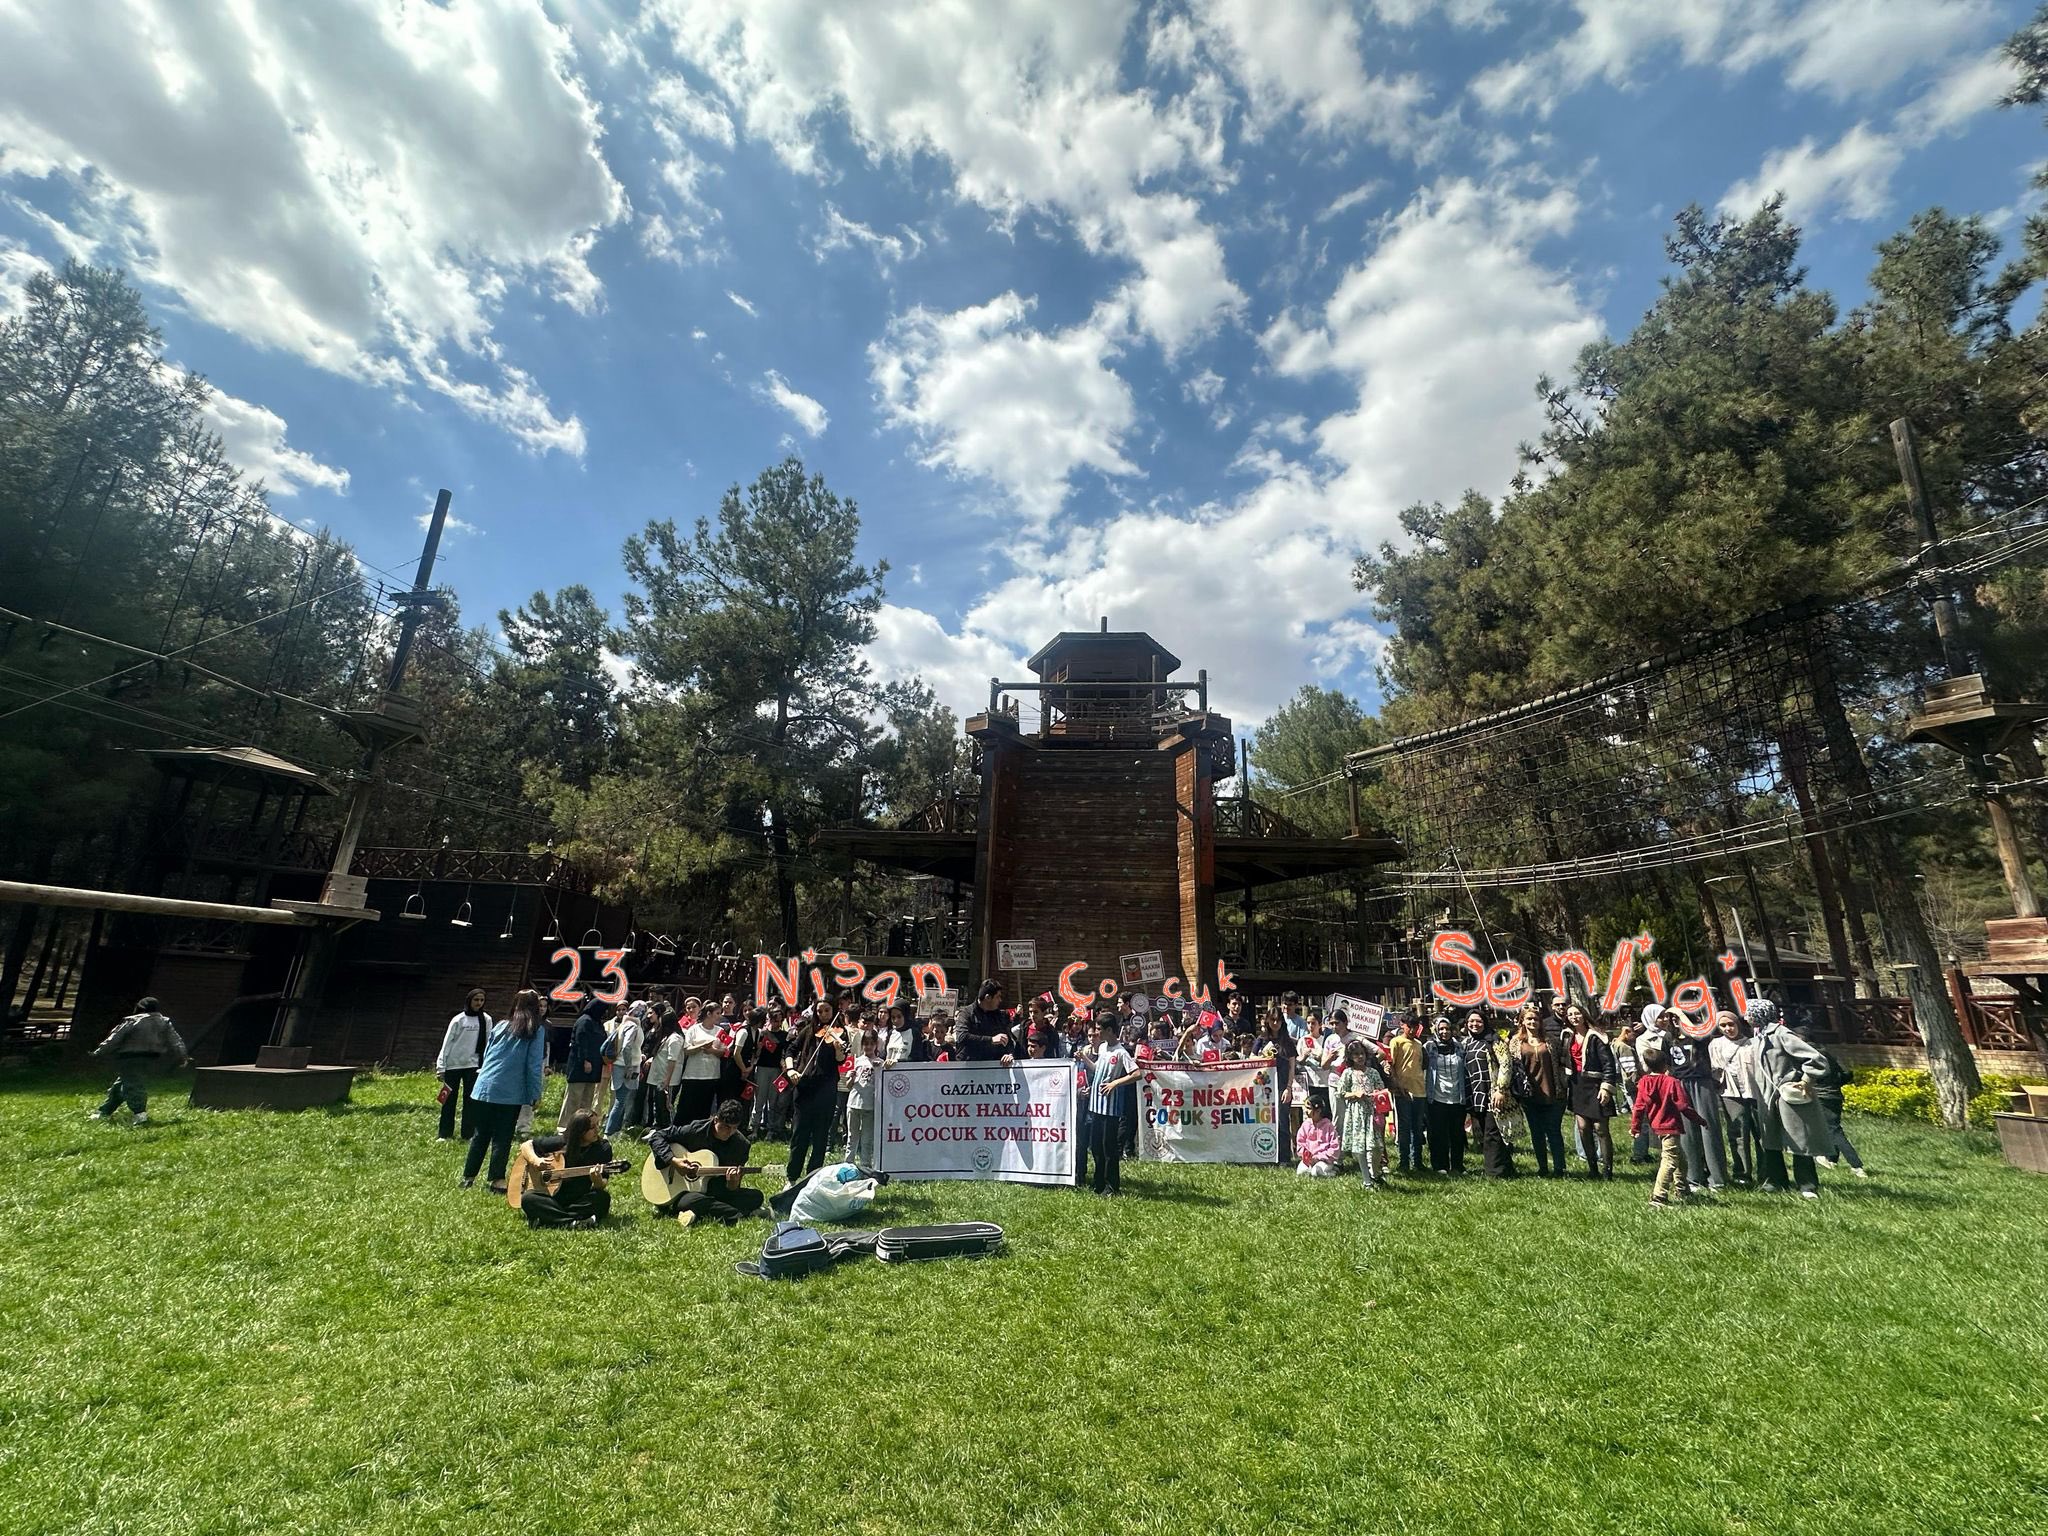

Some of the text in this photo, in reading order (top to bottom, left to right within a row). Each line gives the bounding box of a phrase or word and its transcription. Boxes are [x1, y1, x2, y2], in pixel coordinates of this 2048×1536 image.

[1350, 1003, 1381, 1016] KORUNMA
[1351, 1013, 1376, 1025] HAKKIM
[940, 1079, 1021, 1096] GAZİANTEP
[1161, 1084, 1255, 1107] 23 NİSAN
[904, 1103, 1051, 1122] ÇOCUK HAKLARI
[1145, 1102, 1276, 1130] ÇOCUK ŞENLİĞİ
[887, 1121, 1067, 1146] İL ÇOCUK KOMİTESİ
